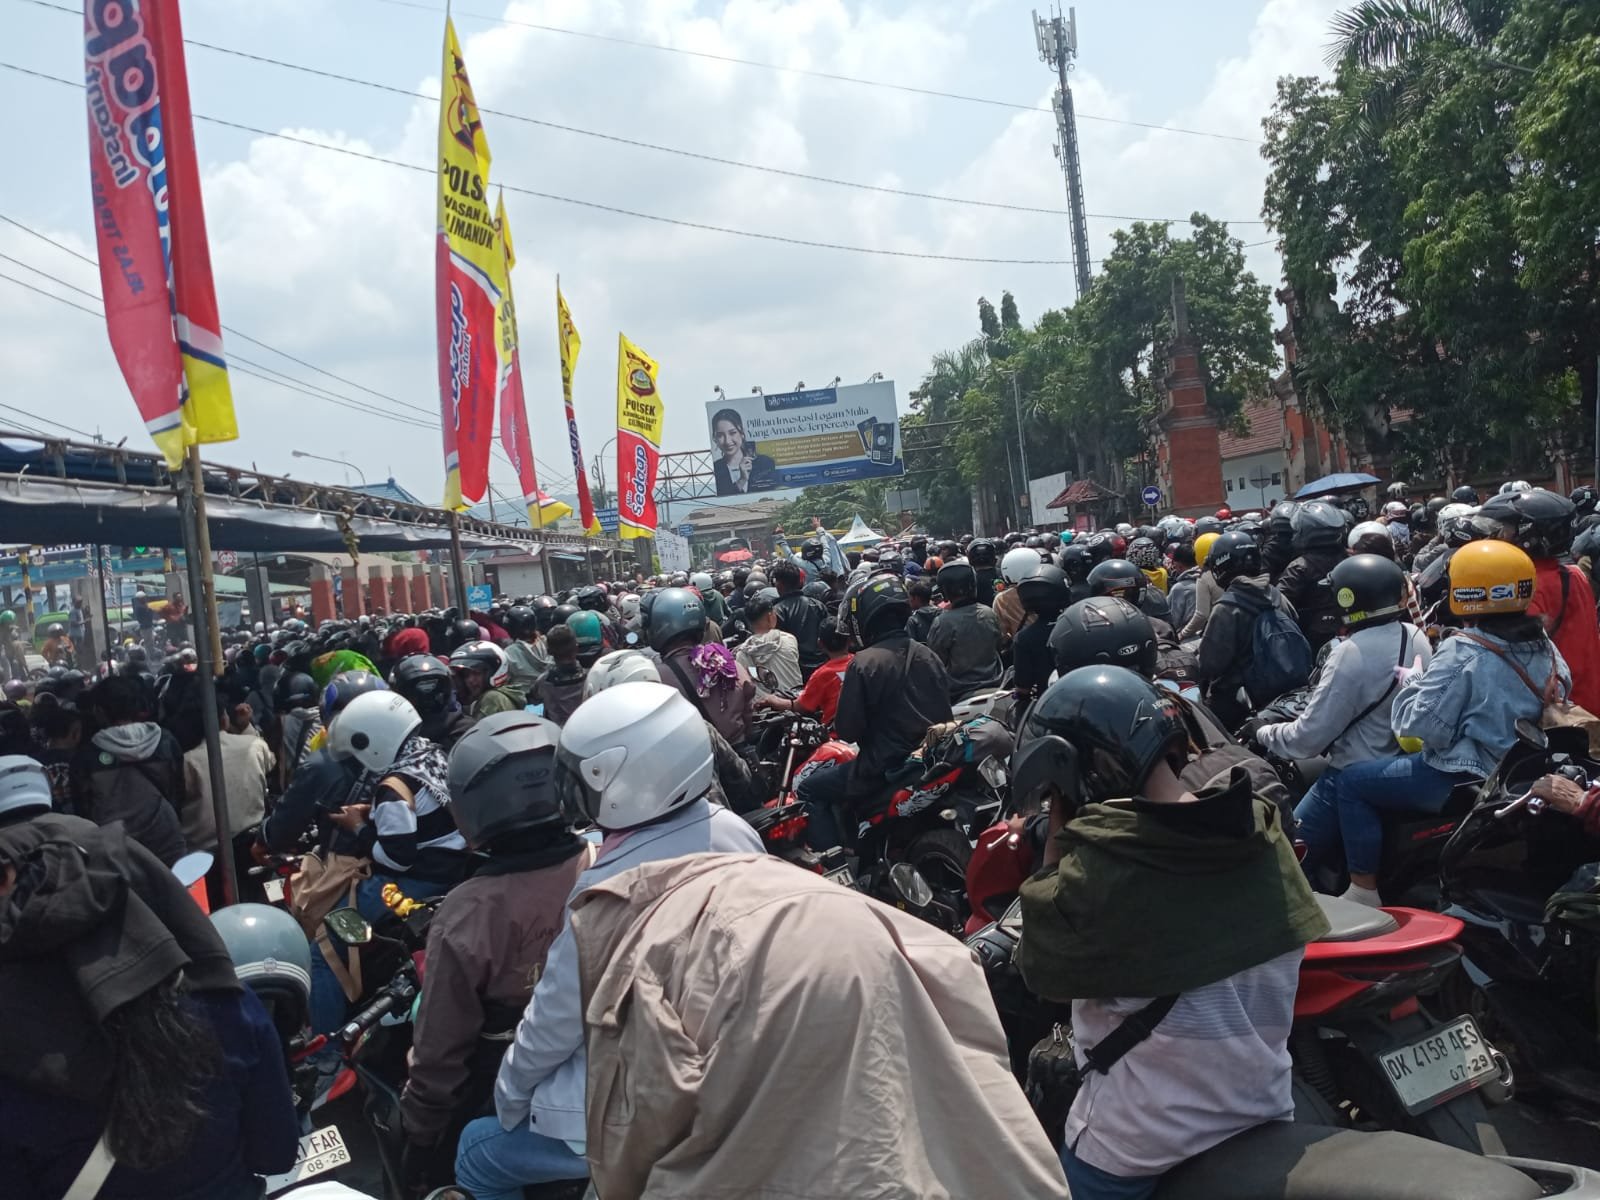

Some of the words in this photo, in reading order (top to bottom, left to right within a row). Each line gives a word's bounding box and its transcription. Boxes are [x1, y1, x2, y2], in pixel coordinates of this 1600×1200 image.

[625, 398, 656, 417] POLSEK
[776, 411, 814, 424] Investasi
[814, 409, 845, 423] Logam
[845, 406, 869, 418] Mulia
[769, 427, 796, 436] Aman
[632, 445, 647, 517] Sedaap
[1387, 1054, 1412, 1080] DK
[1413, 1037, 1449, 1067] 4158
[1448, 1024, 1478, 1051] AES
[310, 1130, 341, 1153] FAR
